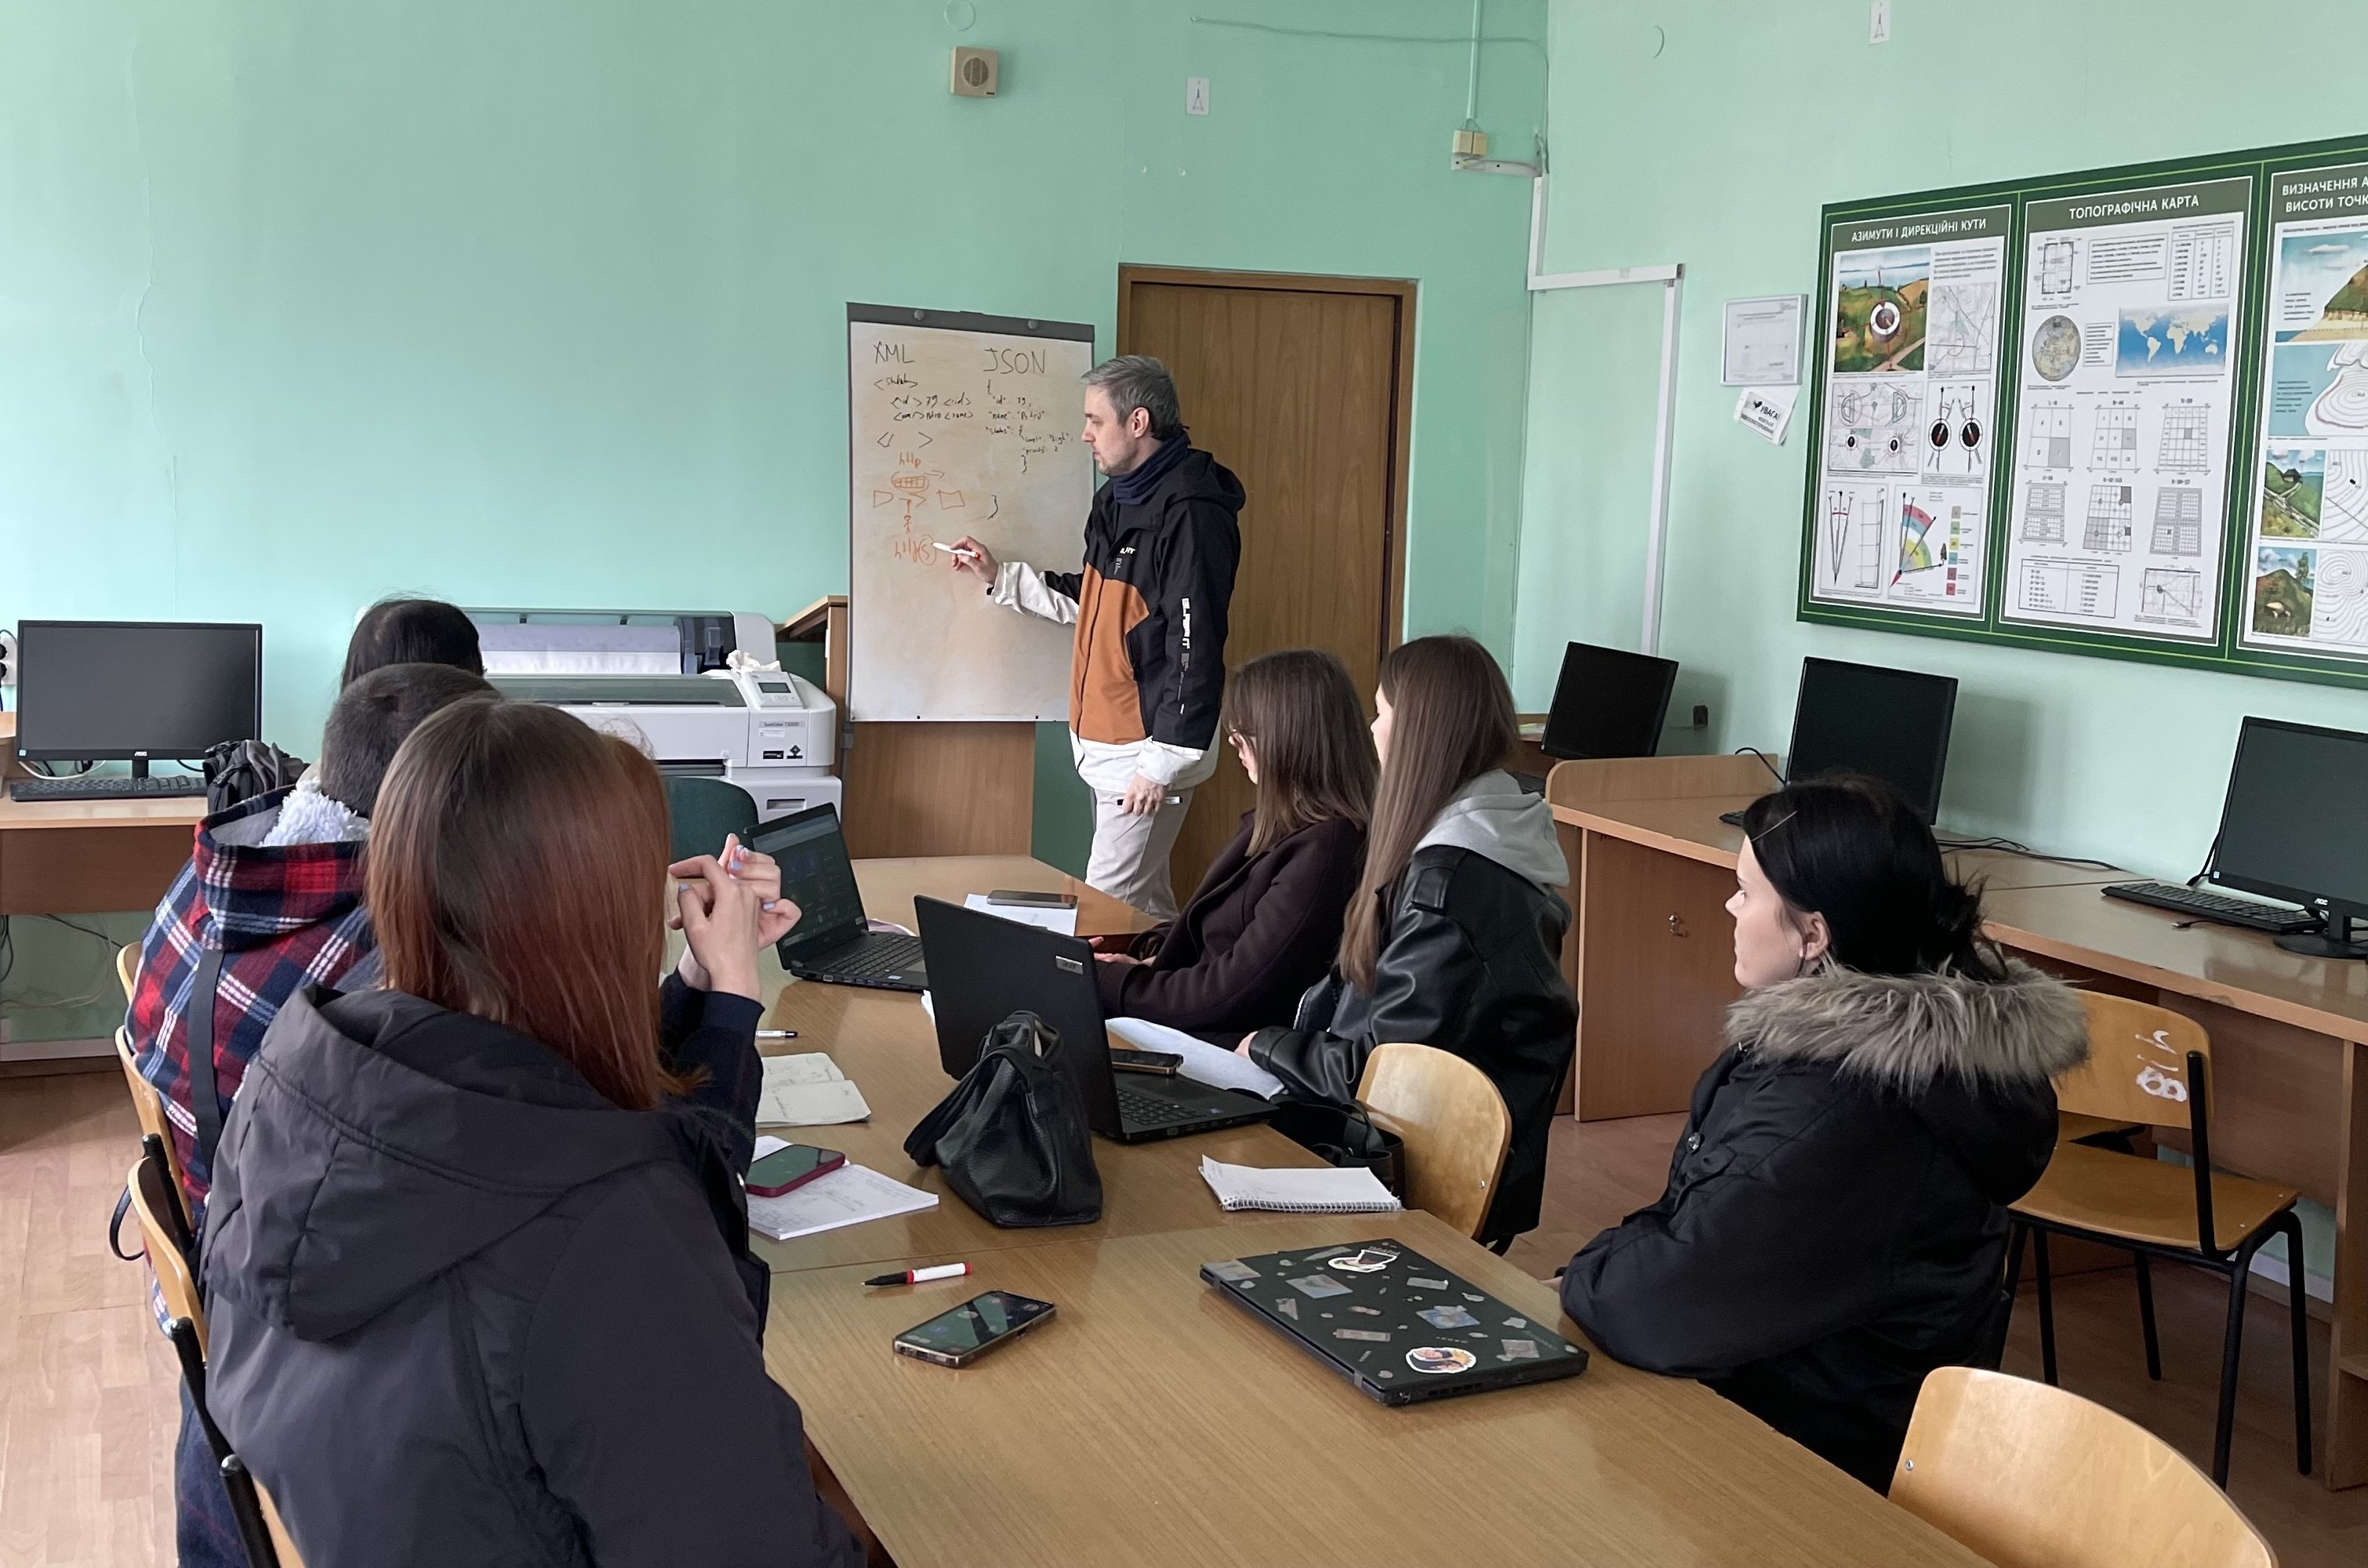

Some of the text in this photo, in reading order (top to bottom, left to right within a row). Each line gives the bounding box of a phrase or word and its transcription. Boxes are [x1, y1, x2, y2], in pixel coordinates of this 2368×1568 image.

[2282, 177, 2358, 196] ВИЗНАЧЕННЯ
[2069, 194, 2199, 220] ТОПОГРАФІЧНА КАРТА
[2286, 198, 2333, 212] ВИСОТИ
[1851, 227, 1893, 241] АЗИМУТИ
[1901, 220, 1958, 238] ДИРЕКЦІЙНІ
[1960, 218, 1986, 231] КУТИ
[873, 341, 915, 364] XML
[983, 347, 1046, 375] JSON
[926, 394, 938, 408] 79
[899, 452, 921, 469] http
